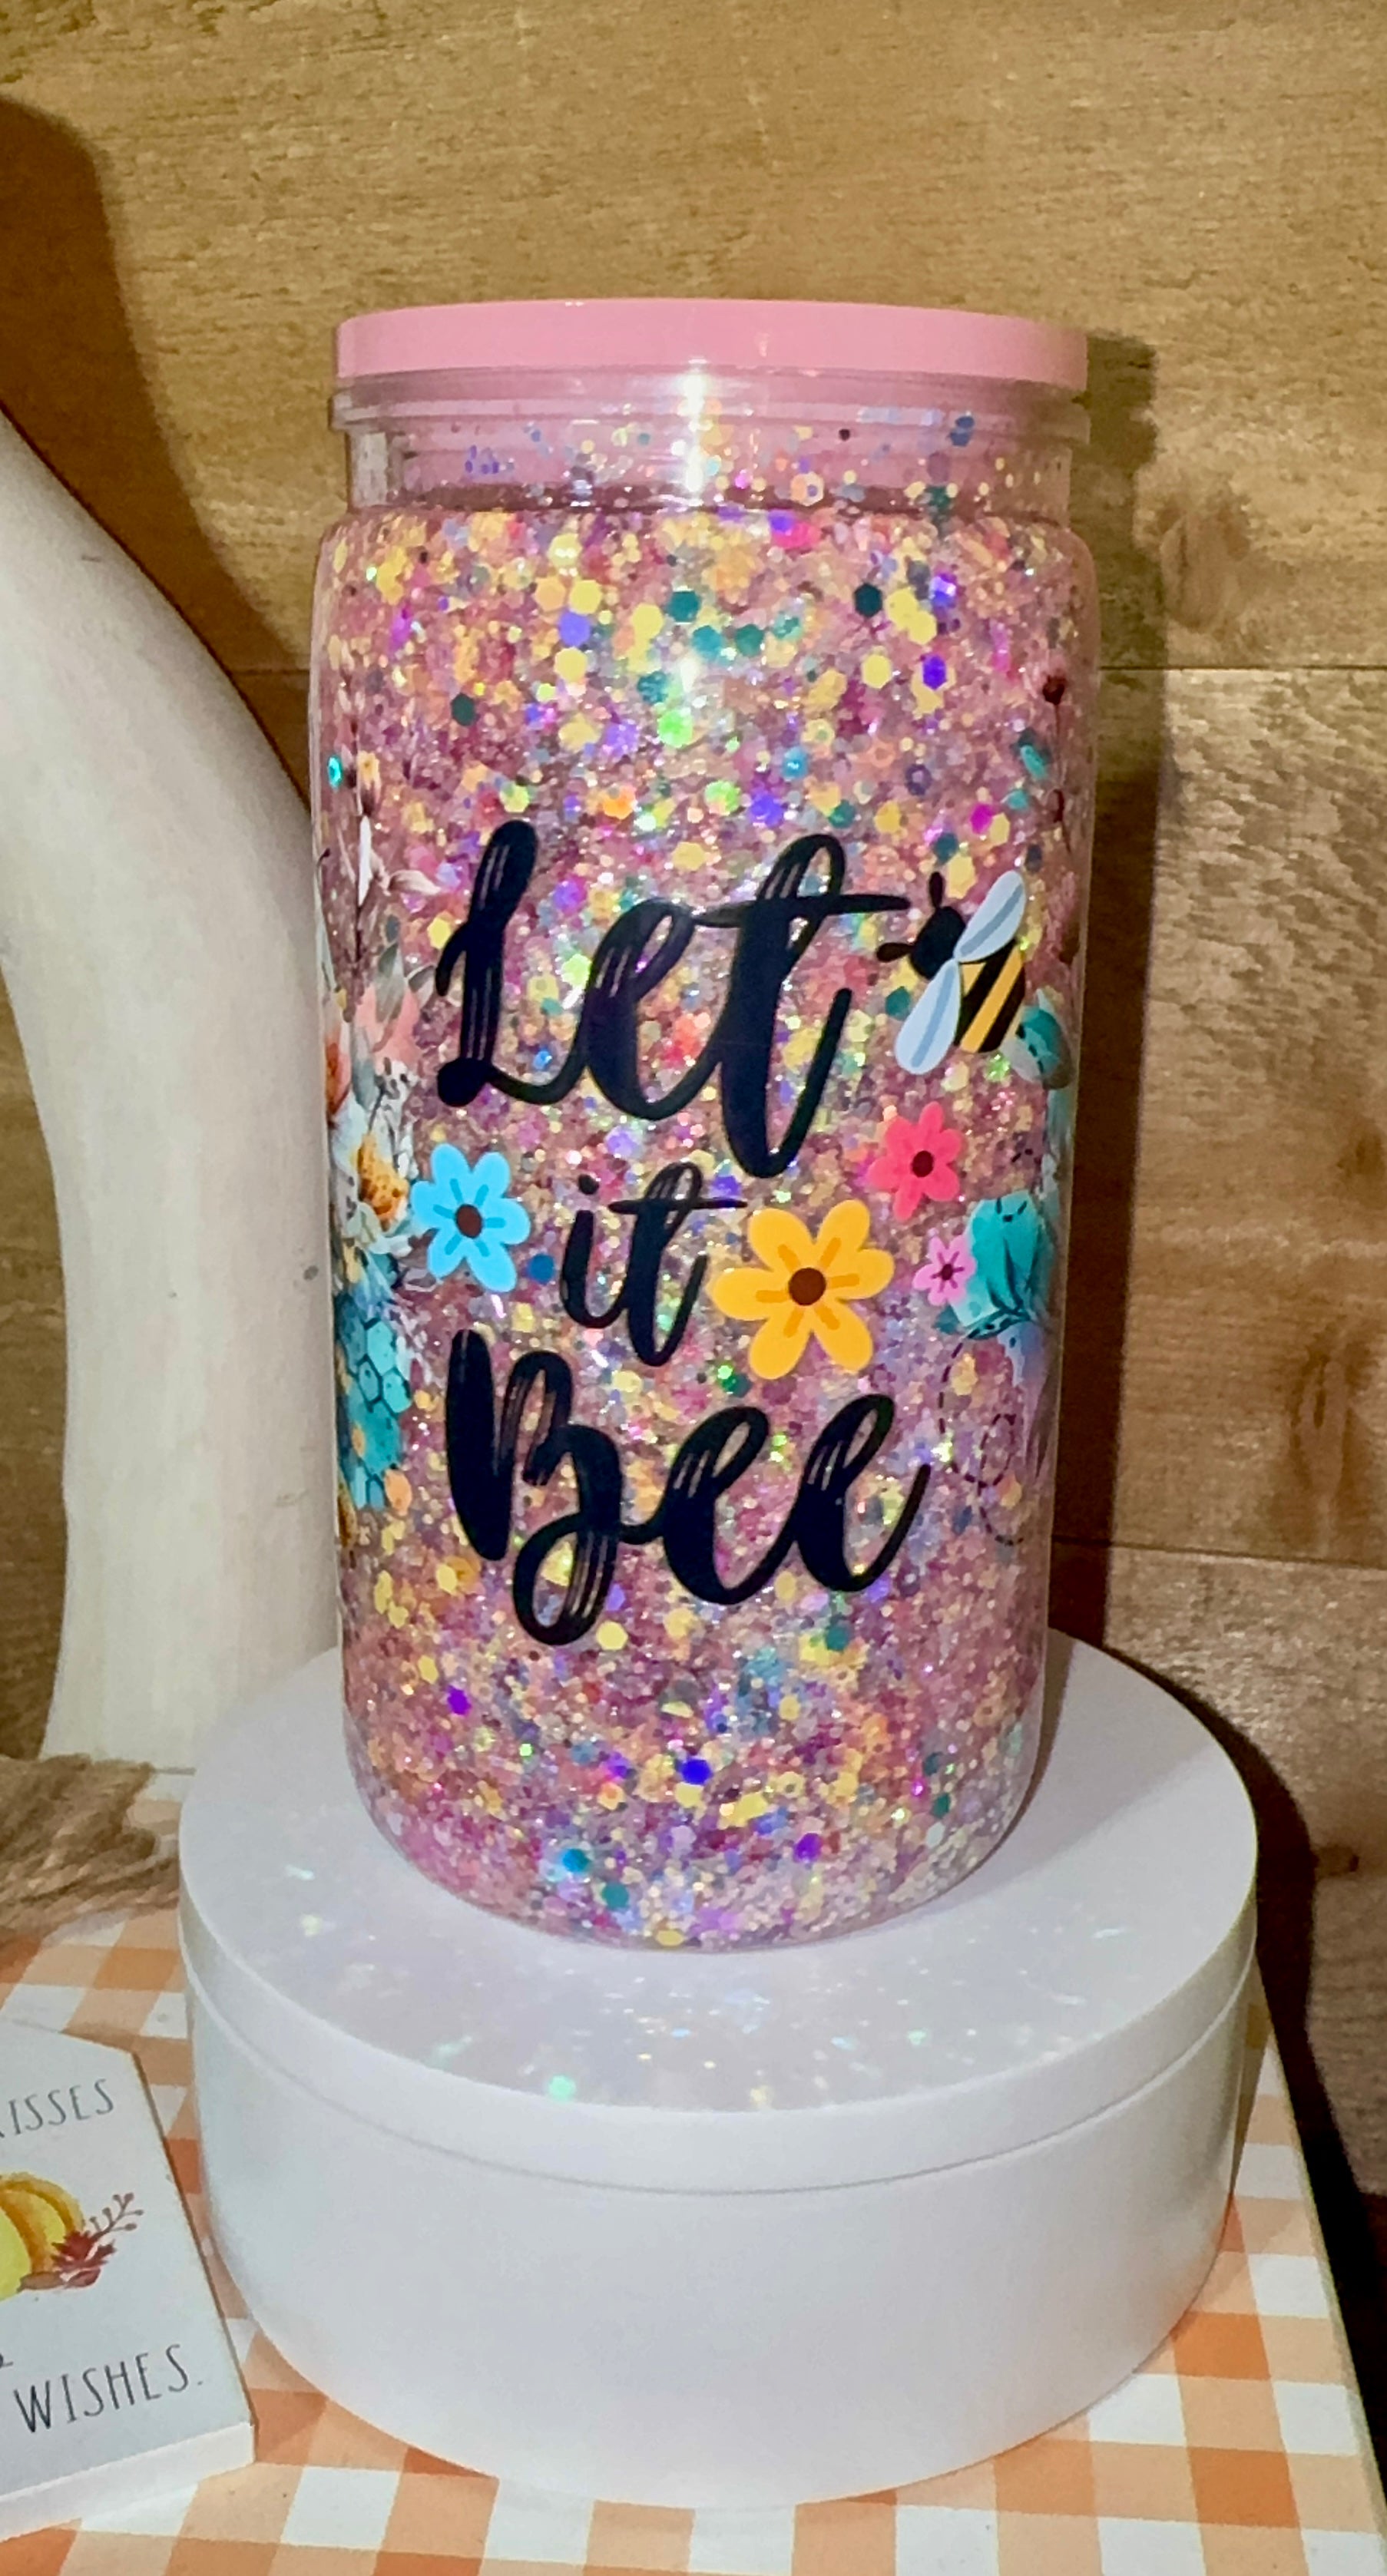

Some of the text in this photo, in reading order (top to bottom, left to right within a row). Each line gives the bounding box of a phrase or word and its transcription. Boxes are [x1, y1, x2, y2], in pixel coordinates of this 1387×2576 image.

[435, 819, 910, 1179] Let
[561, 1162, 747, 1367] it
[445, 1328, 931, 1646] Bee
[0, 2078, 114, 2138] ISSES
[13, 2343, 203, 2433] WISHES.
